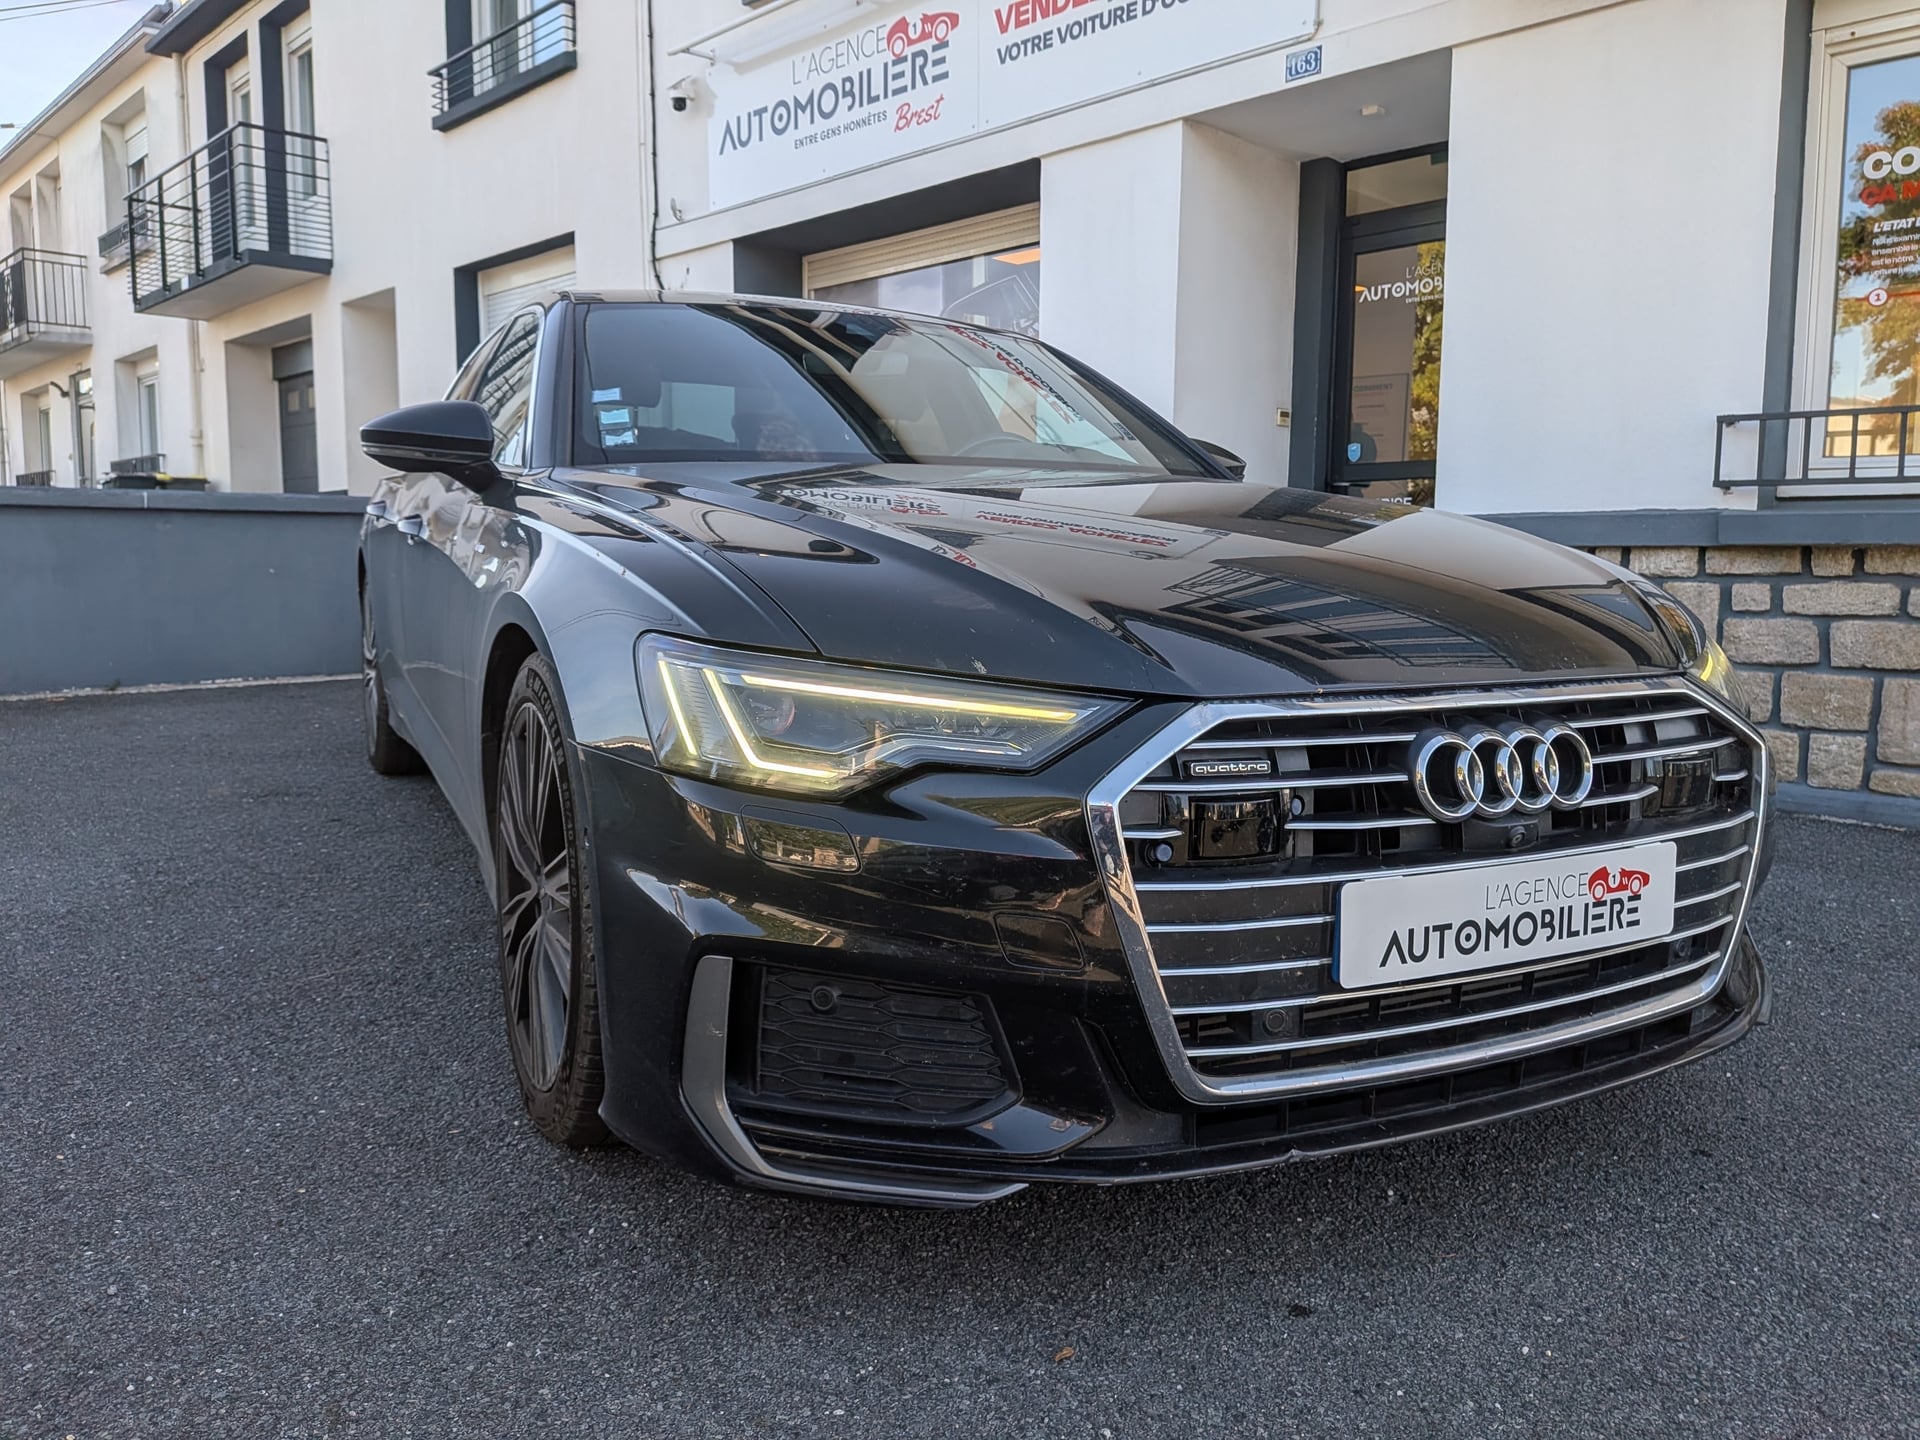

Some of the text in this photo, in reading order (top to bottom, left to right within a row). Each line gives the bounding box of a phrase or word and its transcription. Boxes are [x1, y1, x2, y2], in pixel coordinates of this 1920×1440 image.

[997, 30, 1053, 64] VOTRE
[1056, 1, 1138, 45] VOITURE
[792, 24, 888, 85] L'AGENCE
[1291, 52, 1316, 75] 163
[794, 110, 888, 150] ENTRE GENS HONNÊTES
[894, 94, 945, 133] Brest
[1863, 146, 1920, 179] CO
[1873, 218, 1915, 233] L'ETAT
[533, 676, 565, 766] MICHELIN
[1195, 763, 1268, 775] quattro
[1485, 872, 1589, 910] L'AGENCE
